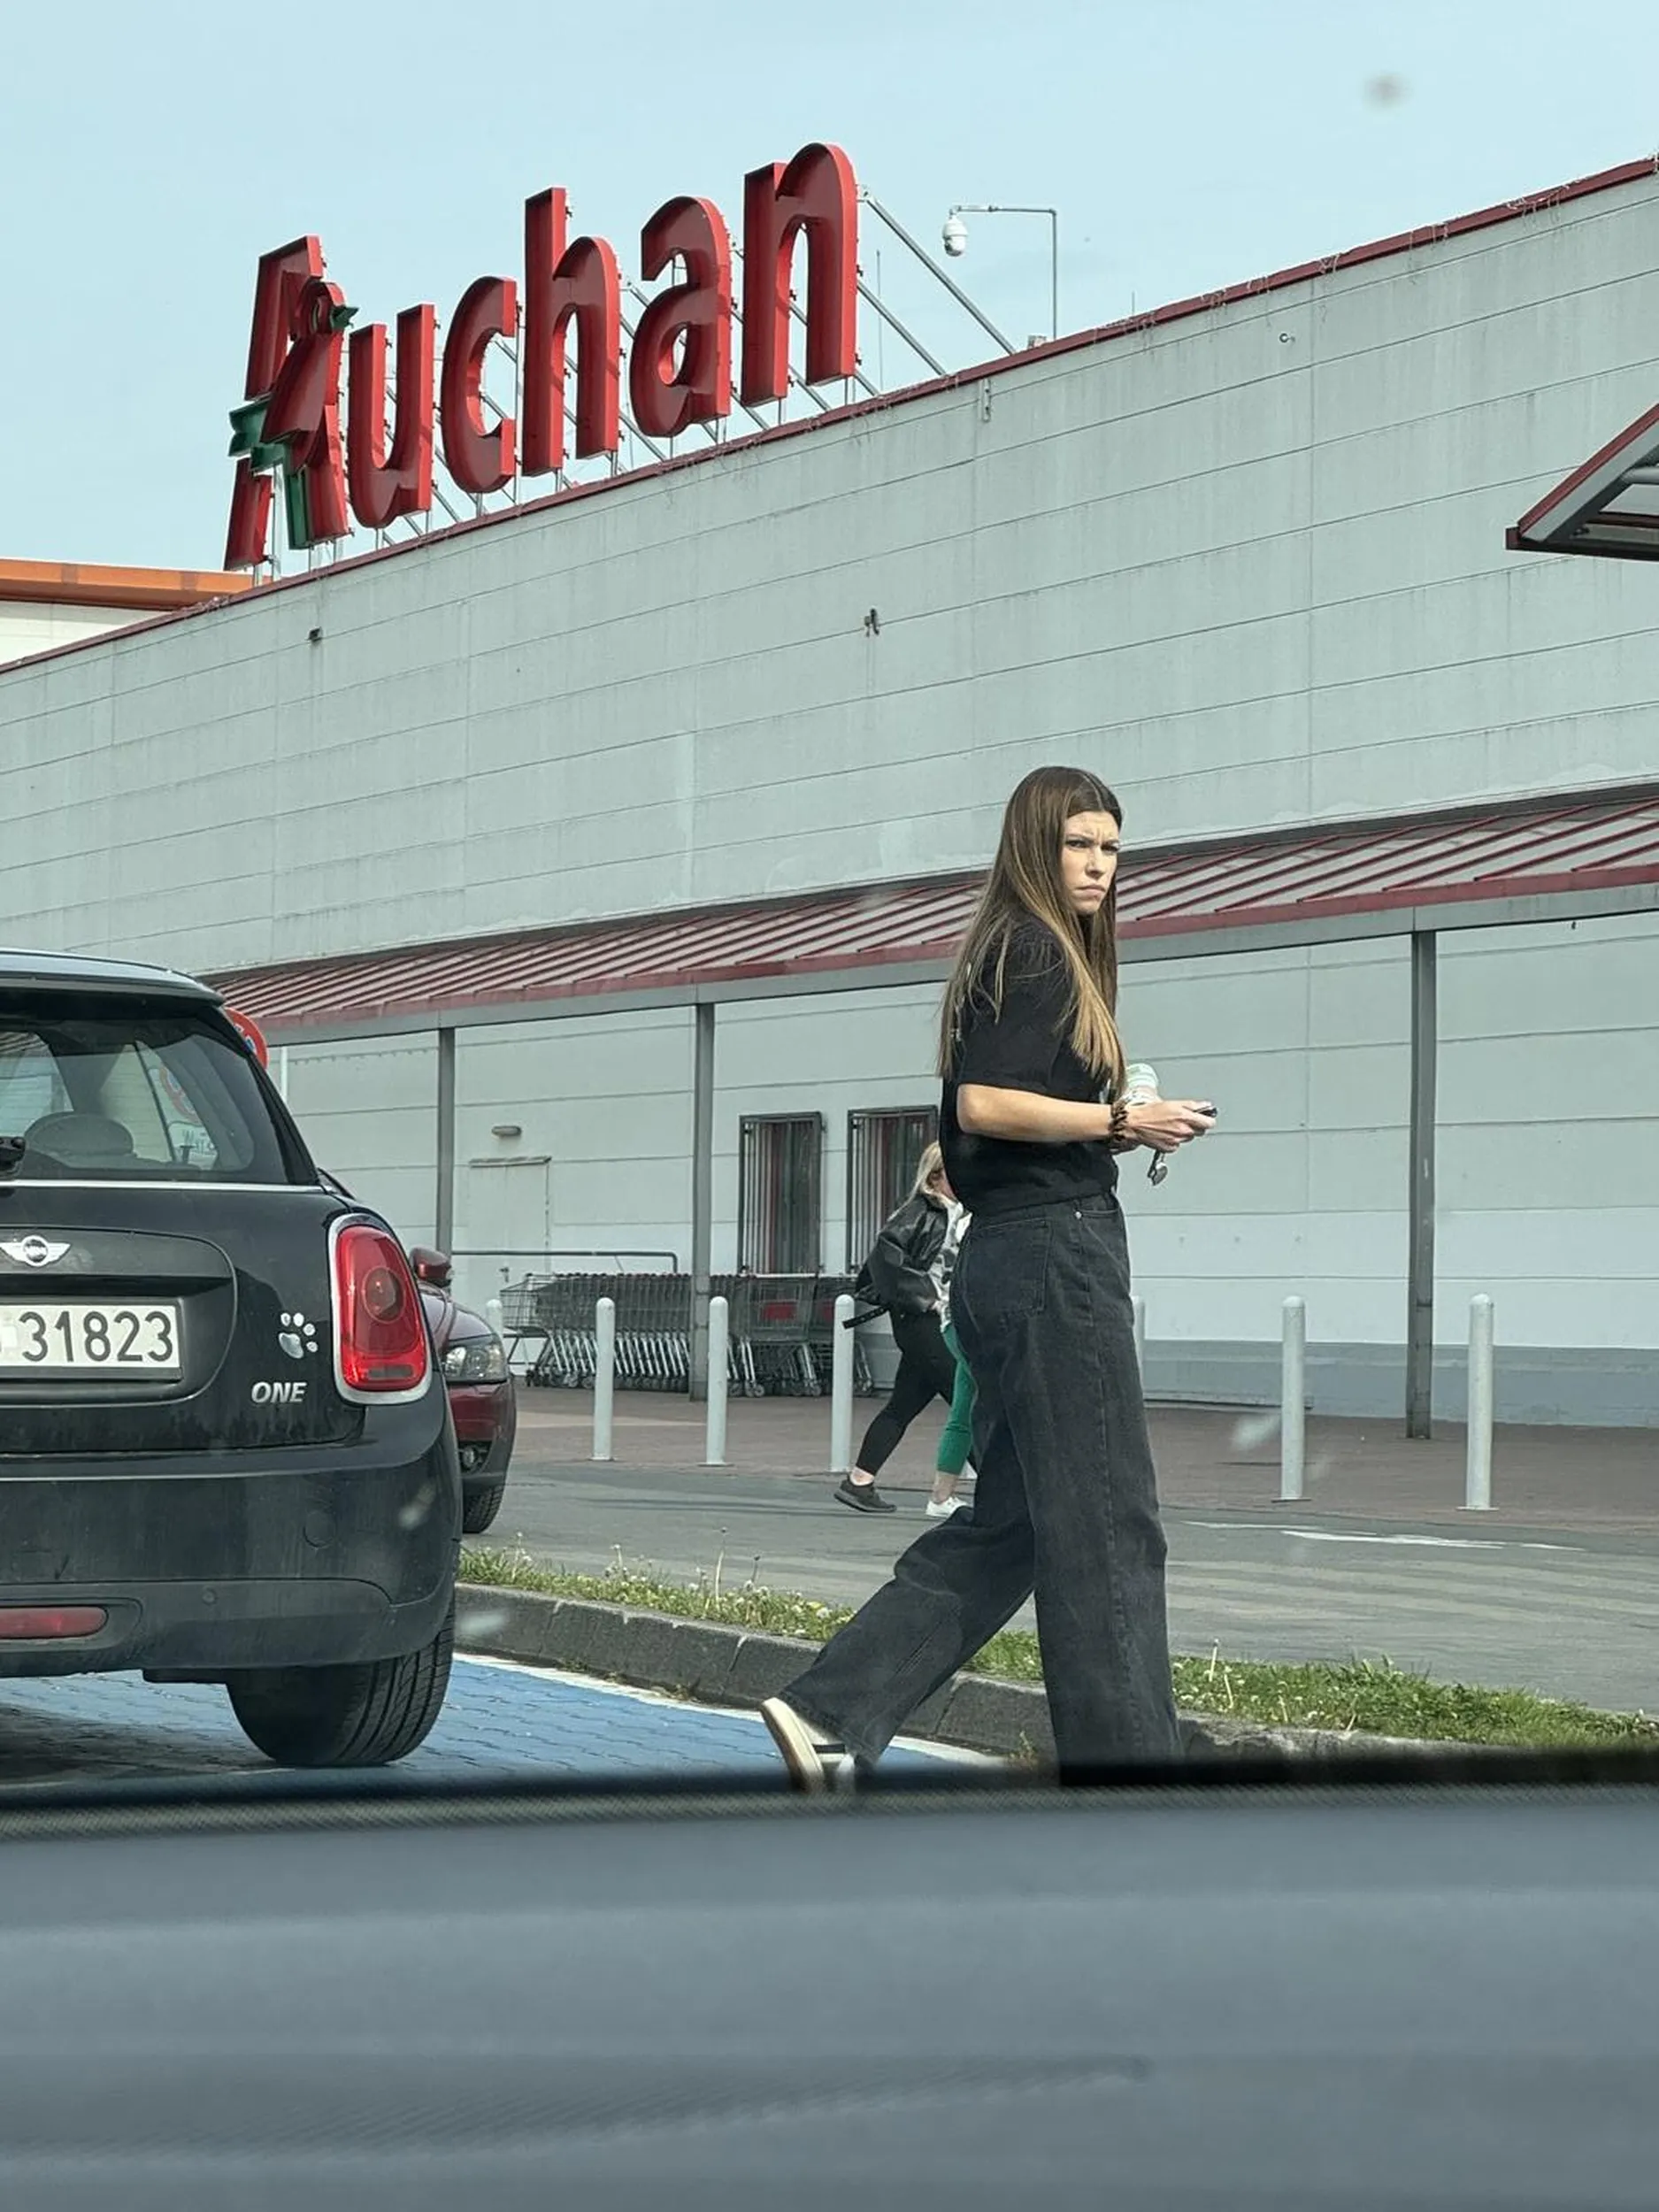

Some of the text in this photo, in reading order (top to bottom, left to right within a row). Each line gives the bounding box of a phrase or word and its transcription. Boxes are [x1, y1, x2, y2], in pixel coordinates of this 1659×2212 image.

[224, 142, 859, 572] Auchan
[19, 1310, 173, 1363] 31823
[251, 1381, 308, 1403] ONE
